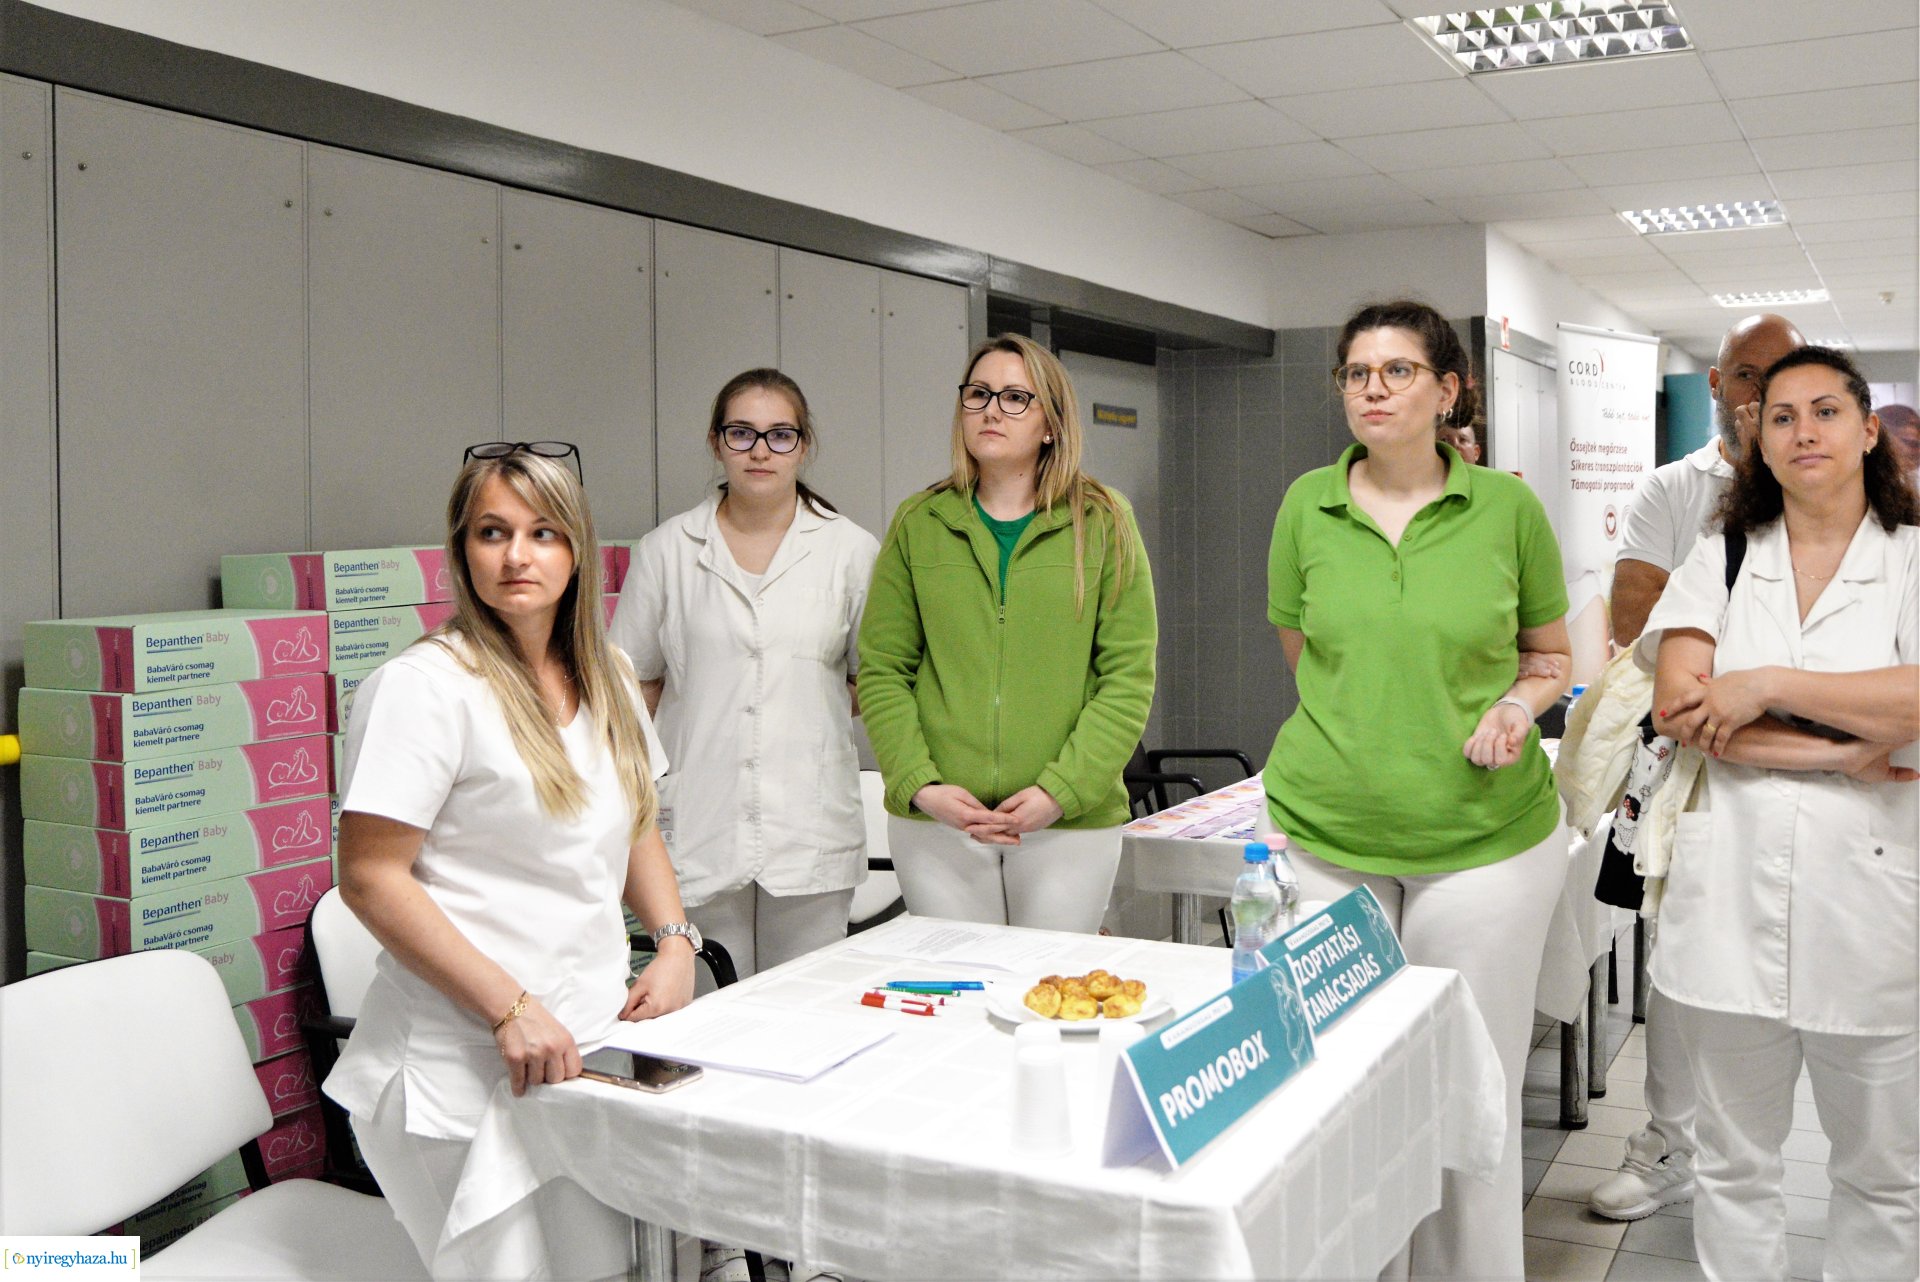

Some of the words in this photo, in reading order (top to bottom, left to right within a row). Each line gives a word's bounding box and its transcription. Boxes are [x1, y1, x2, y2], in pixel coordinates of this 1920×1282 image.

[1568, 360, 1598, 377] CORD
[1570, 437, 1597, 454] Őssejtek
[1570, 459, 1594, 471] Sikeres
[1603, 480, 1635, 493] programok
[334, 562, 379, 573] Bepanthen
[381, 560, 400, 571] Baby
[365, 586, 389, 594] csomag
[335, 596, 358, 604] kiemelt
[359, 594, 385, 603] partnere
[334, 618, 379, 629] Bepanthen
[382, 616, 401, 627] Baby
[146, 635, 203, 649] Bepanthen
[205, 631, 230, 645] Baby
[365, 641, 389, 650] csomag
[335, 651, 359, 661] kiemelt
[359, 649, 386, 660] partnere
[147, 663, 184, 674] BabaVáró
[185, 661, 215, 671] csomag
[147, 674, 176, 684] kiemelt
[177, 671, 211, 683] partnere
[132, 697, 192, 713] Bepanthen
[196, 694, 221, 706] Baby
[133, 726, 172, 738] BabaVáró
[173, 723, 204, 733] csomag
[133, 736, 163, 748] kiemelt
[164, 733, 200, 746] partnere
[134, 763, 193, 780] Bepanthen
[198, 758, 223, 771] Baby
[135, 792, 174, 806] BabaVáró
[174, 788, 206, 799] csomag
[135, 803, 165, 815] kiemelt
[166, 799, 201, 812] partnere
[140, 830, 199, 849] Bepanthen
[203, 825, 228, 838] Baby
[141, 859, 180, 875] BabaVáró
[180, 855, 211, 867] csomag
[141, 872, 171, 885] kiemelt
[172, 865, 207, 880] partnere
[142, 899, 202, 920] Bepanthen
[204, 892, 229, 906] Baby
[143, 930, 182, 946] BabaVáró
[183, 923, 214, 936] csomag
[174, 934, 210, 950] partnere
[211, 953, 235, 967] Baby
[1291, 923, 1363, 986] ZOPTATÁSI
[1302, 952, 1382, 1026] TANÁCSADÁS
[1159, 1030, 1270, 1128] PROMOBOX
[141, 1222, 194, 1251] epanthen
